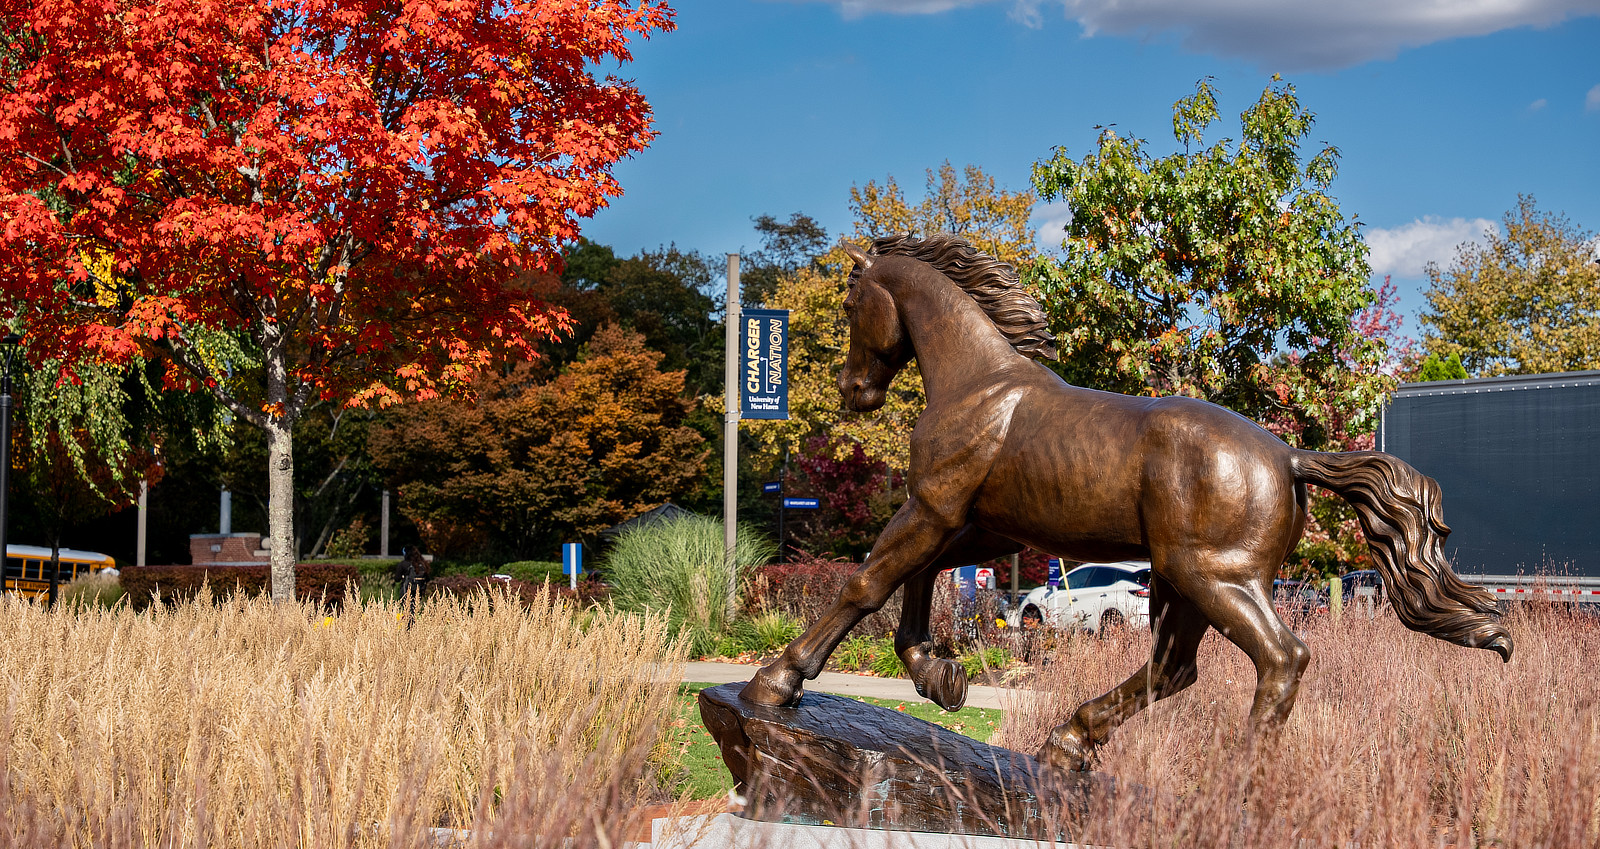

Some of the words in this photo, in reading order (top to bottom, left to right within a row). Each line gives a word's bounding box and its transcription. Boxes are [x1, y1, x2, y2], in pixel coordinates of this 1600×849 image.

[747, 318, 760, 393] CHARGER
[769, 318, 783, 385] NATION
[748, 395, 773, 404] University
[774, 395, 781, 404] of
